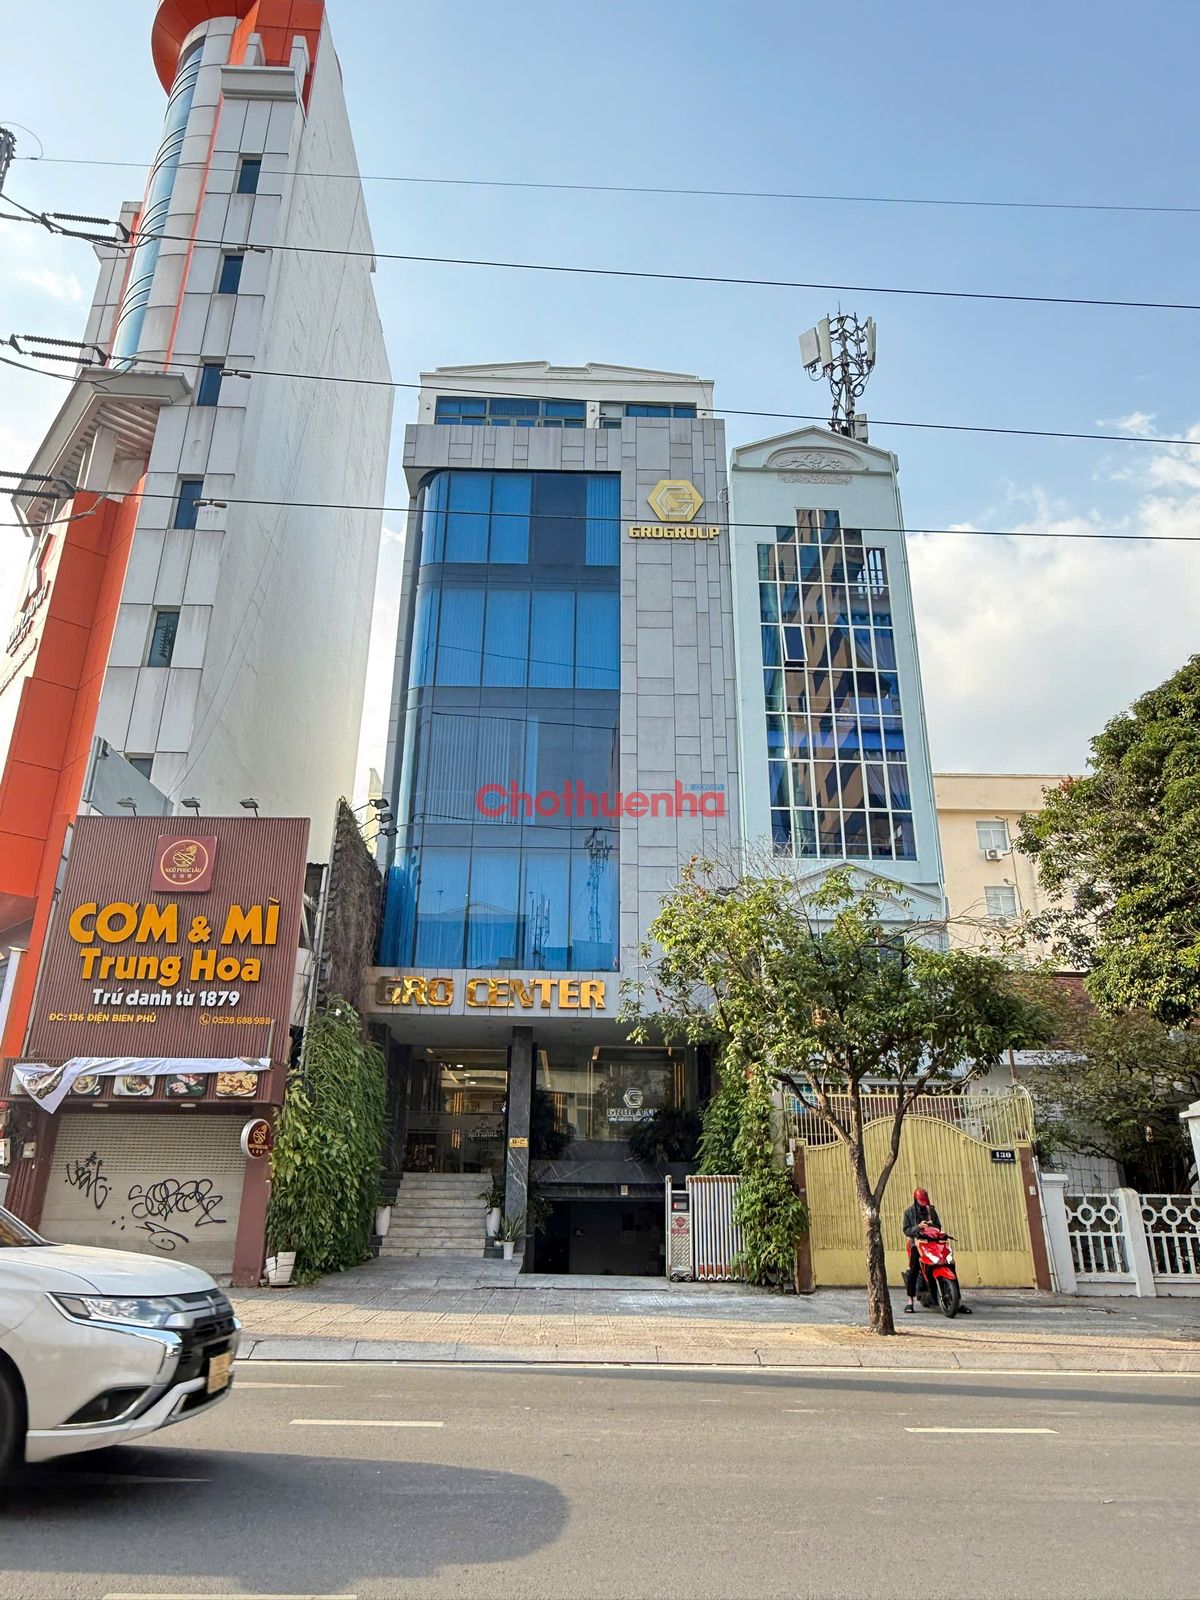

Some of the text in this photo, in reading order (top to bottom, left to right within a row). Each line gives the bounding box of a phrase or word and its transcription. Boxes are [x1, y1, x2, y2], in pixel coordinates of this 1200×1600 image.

[629, 526, 720, 539] GROGROUP
[68, 896, 280, 945] CƠM & MÌ
[79, 947, 261, 987] Trung Hoa
[92, 987, 240, 1007] Trú danh từ 1879
[375, 975, 607, 1010] GRO CENTER
[212, 1016, 235, 1024] 0528
